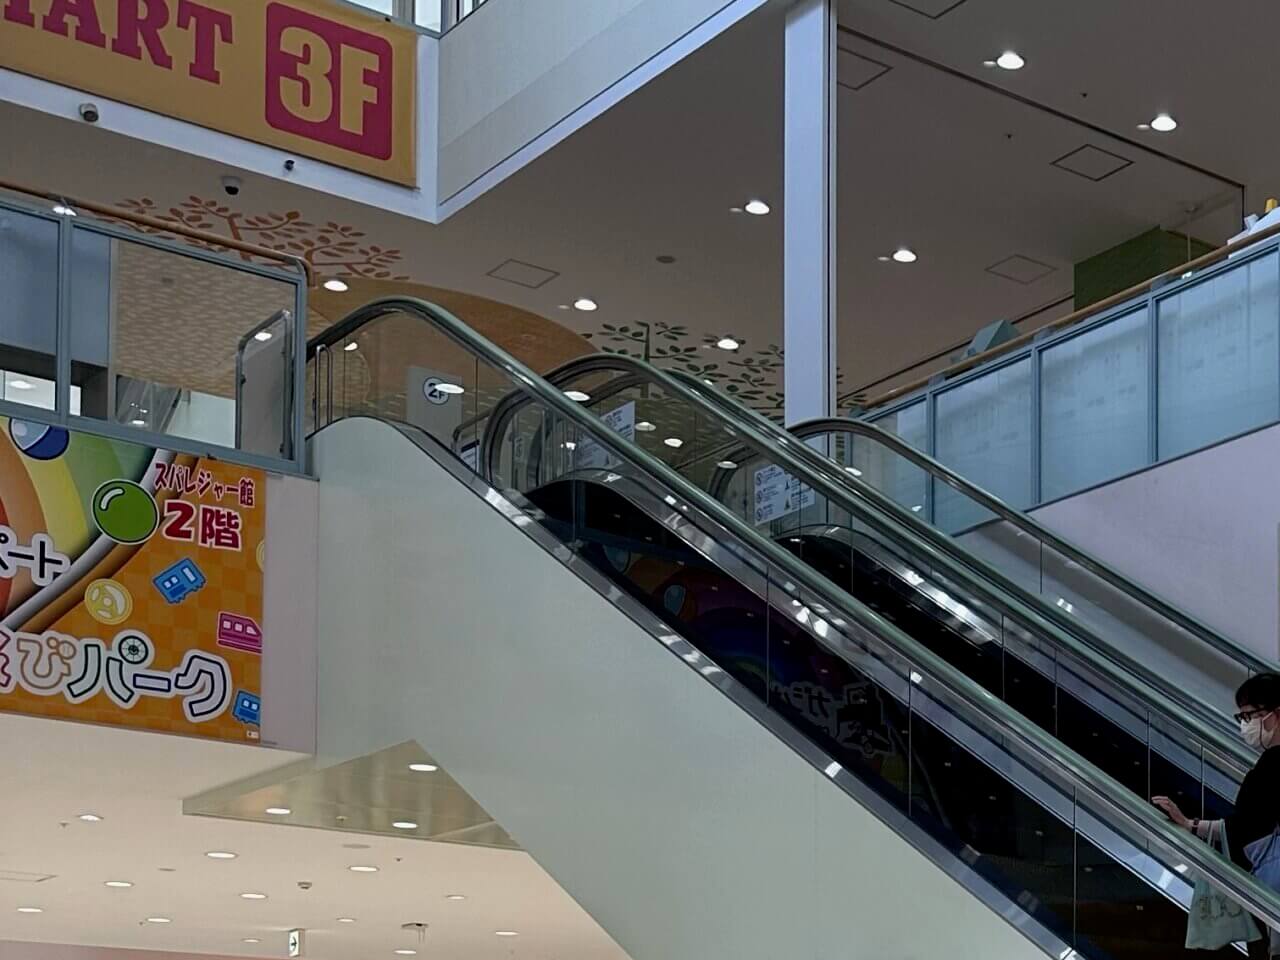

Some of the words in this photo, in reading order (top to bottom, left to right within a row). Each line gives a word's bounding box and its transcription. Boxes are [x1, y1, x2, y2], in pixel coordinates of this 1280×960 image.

[3, 0, 233, 85] ART
[279, 25, 381, 137] 3F
[155, 462, 255, 507] スパレジャー館
[164, 500, 241, 550] 2階
